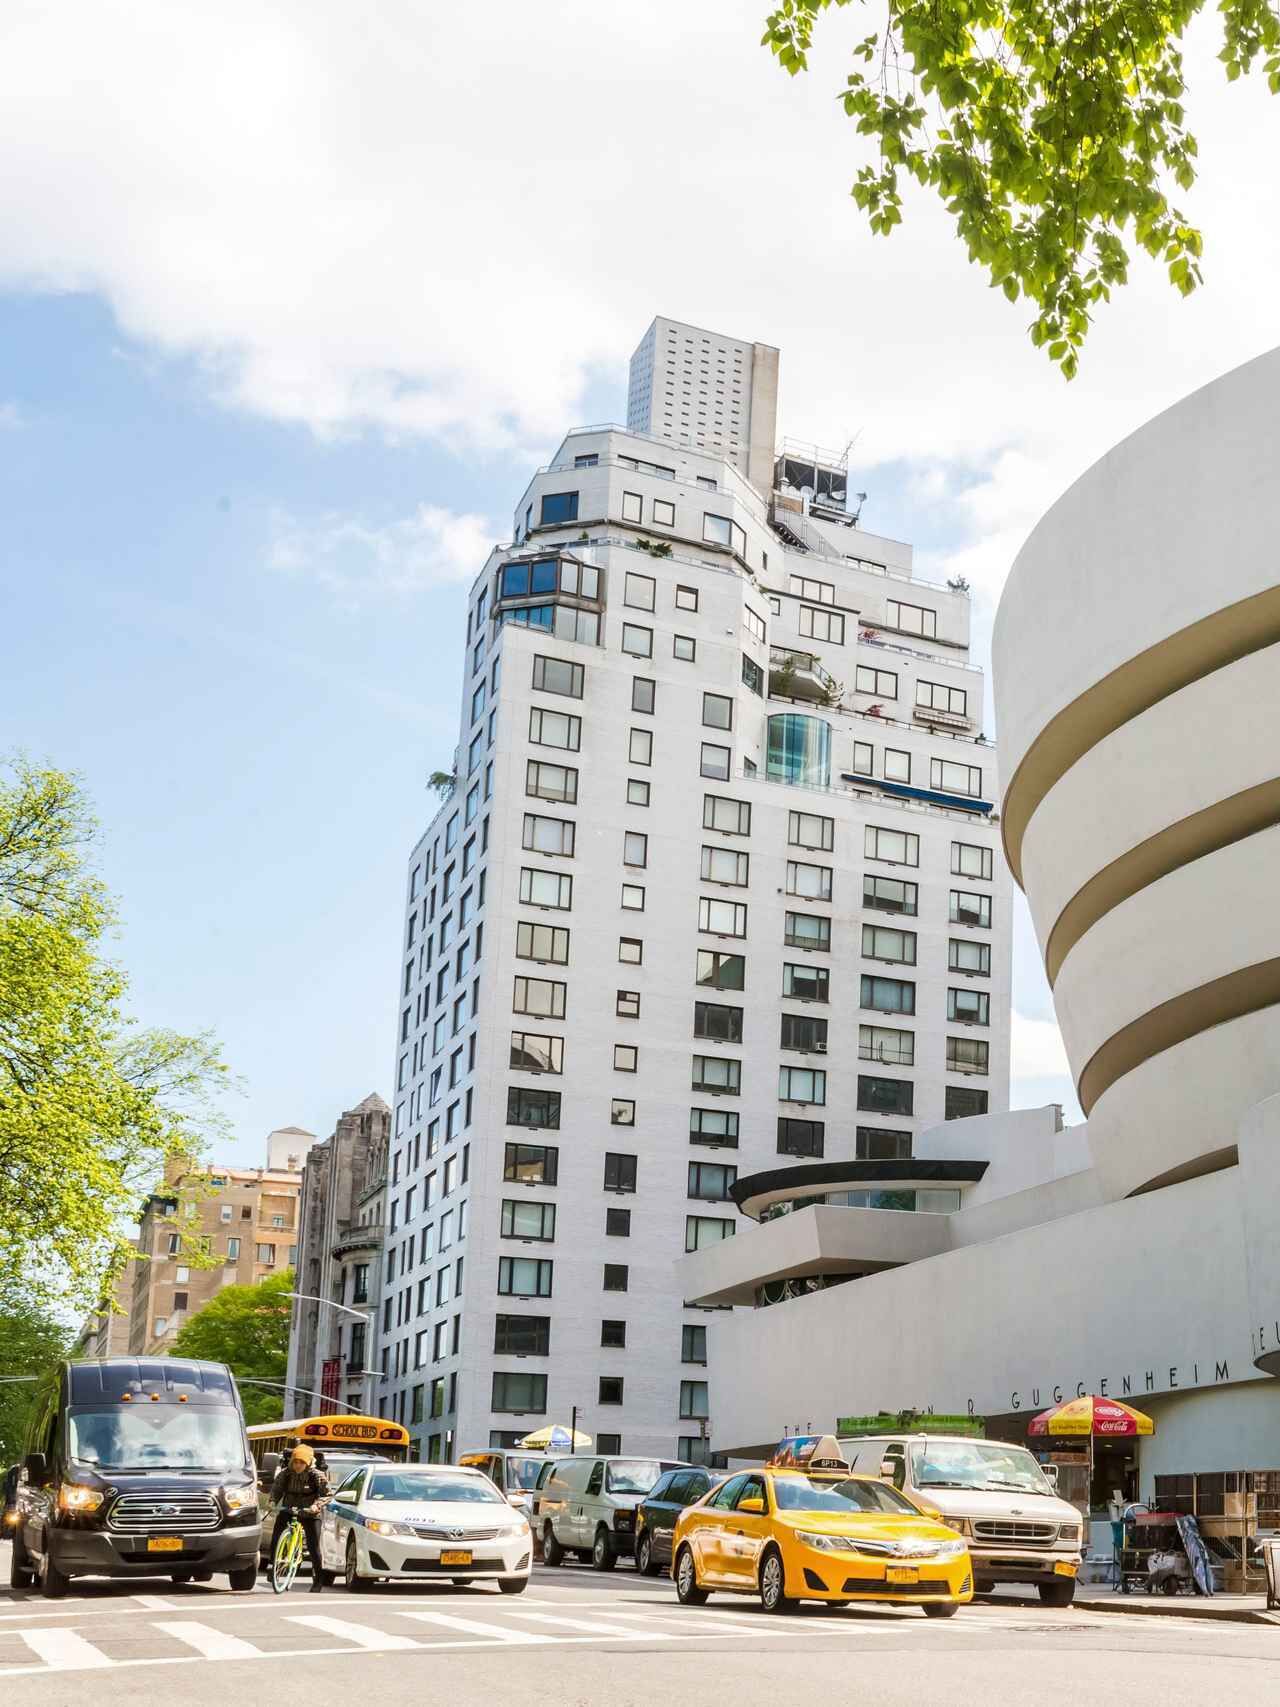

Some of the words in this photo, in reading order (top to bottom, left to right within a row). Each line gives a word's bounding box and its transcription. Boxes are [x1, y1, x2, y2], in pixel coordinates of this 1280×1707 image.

[1011, 1359, 1231, 1409] GUGGENHEIM
[333, 1424, 361, 1437] SCHOOL
[362, 1425, 377, 1438] BUS
